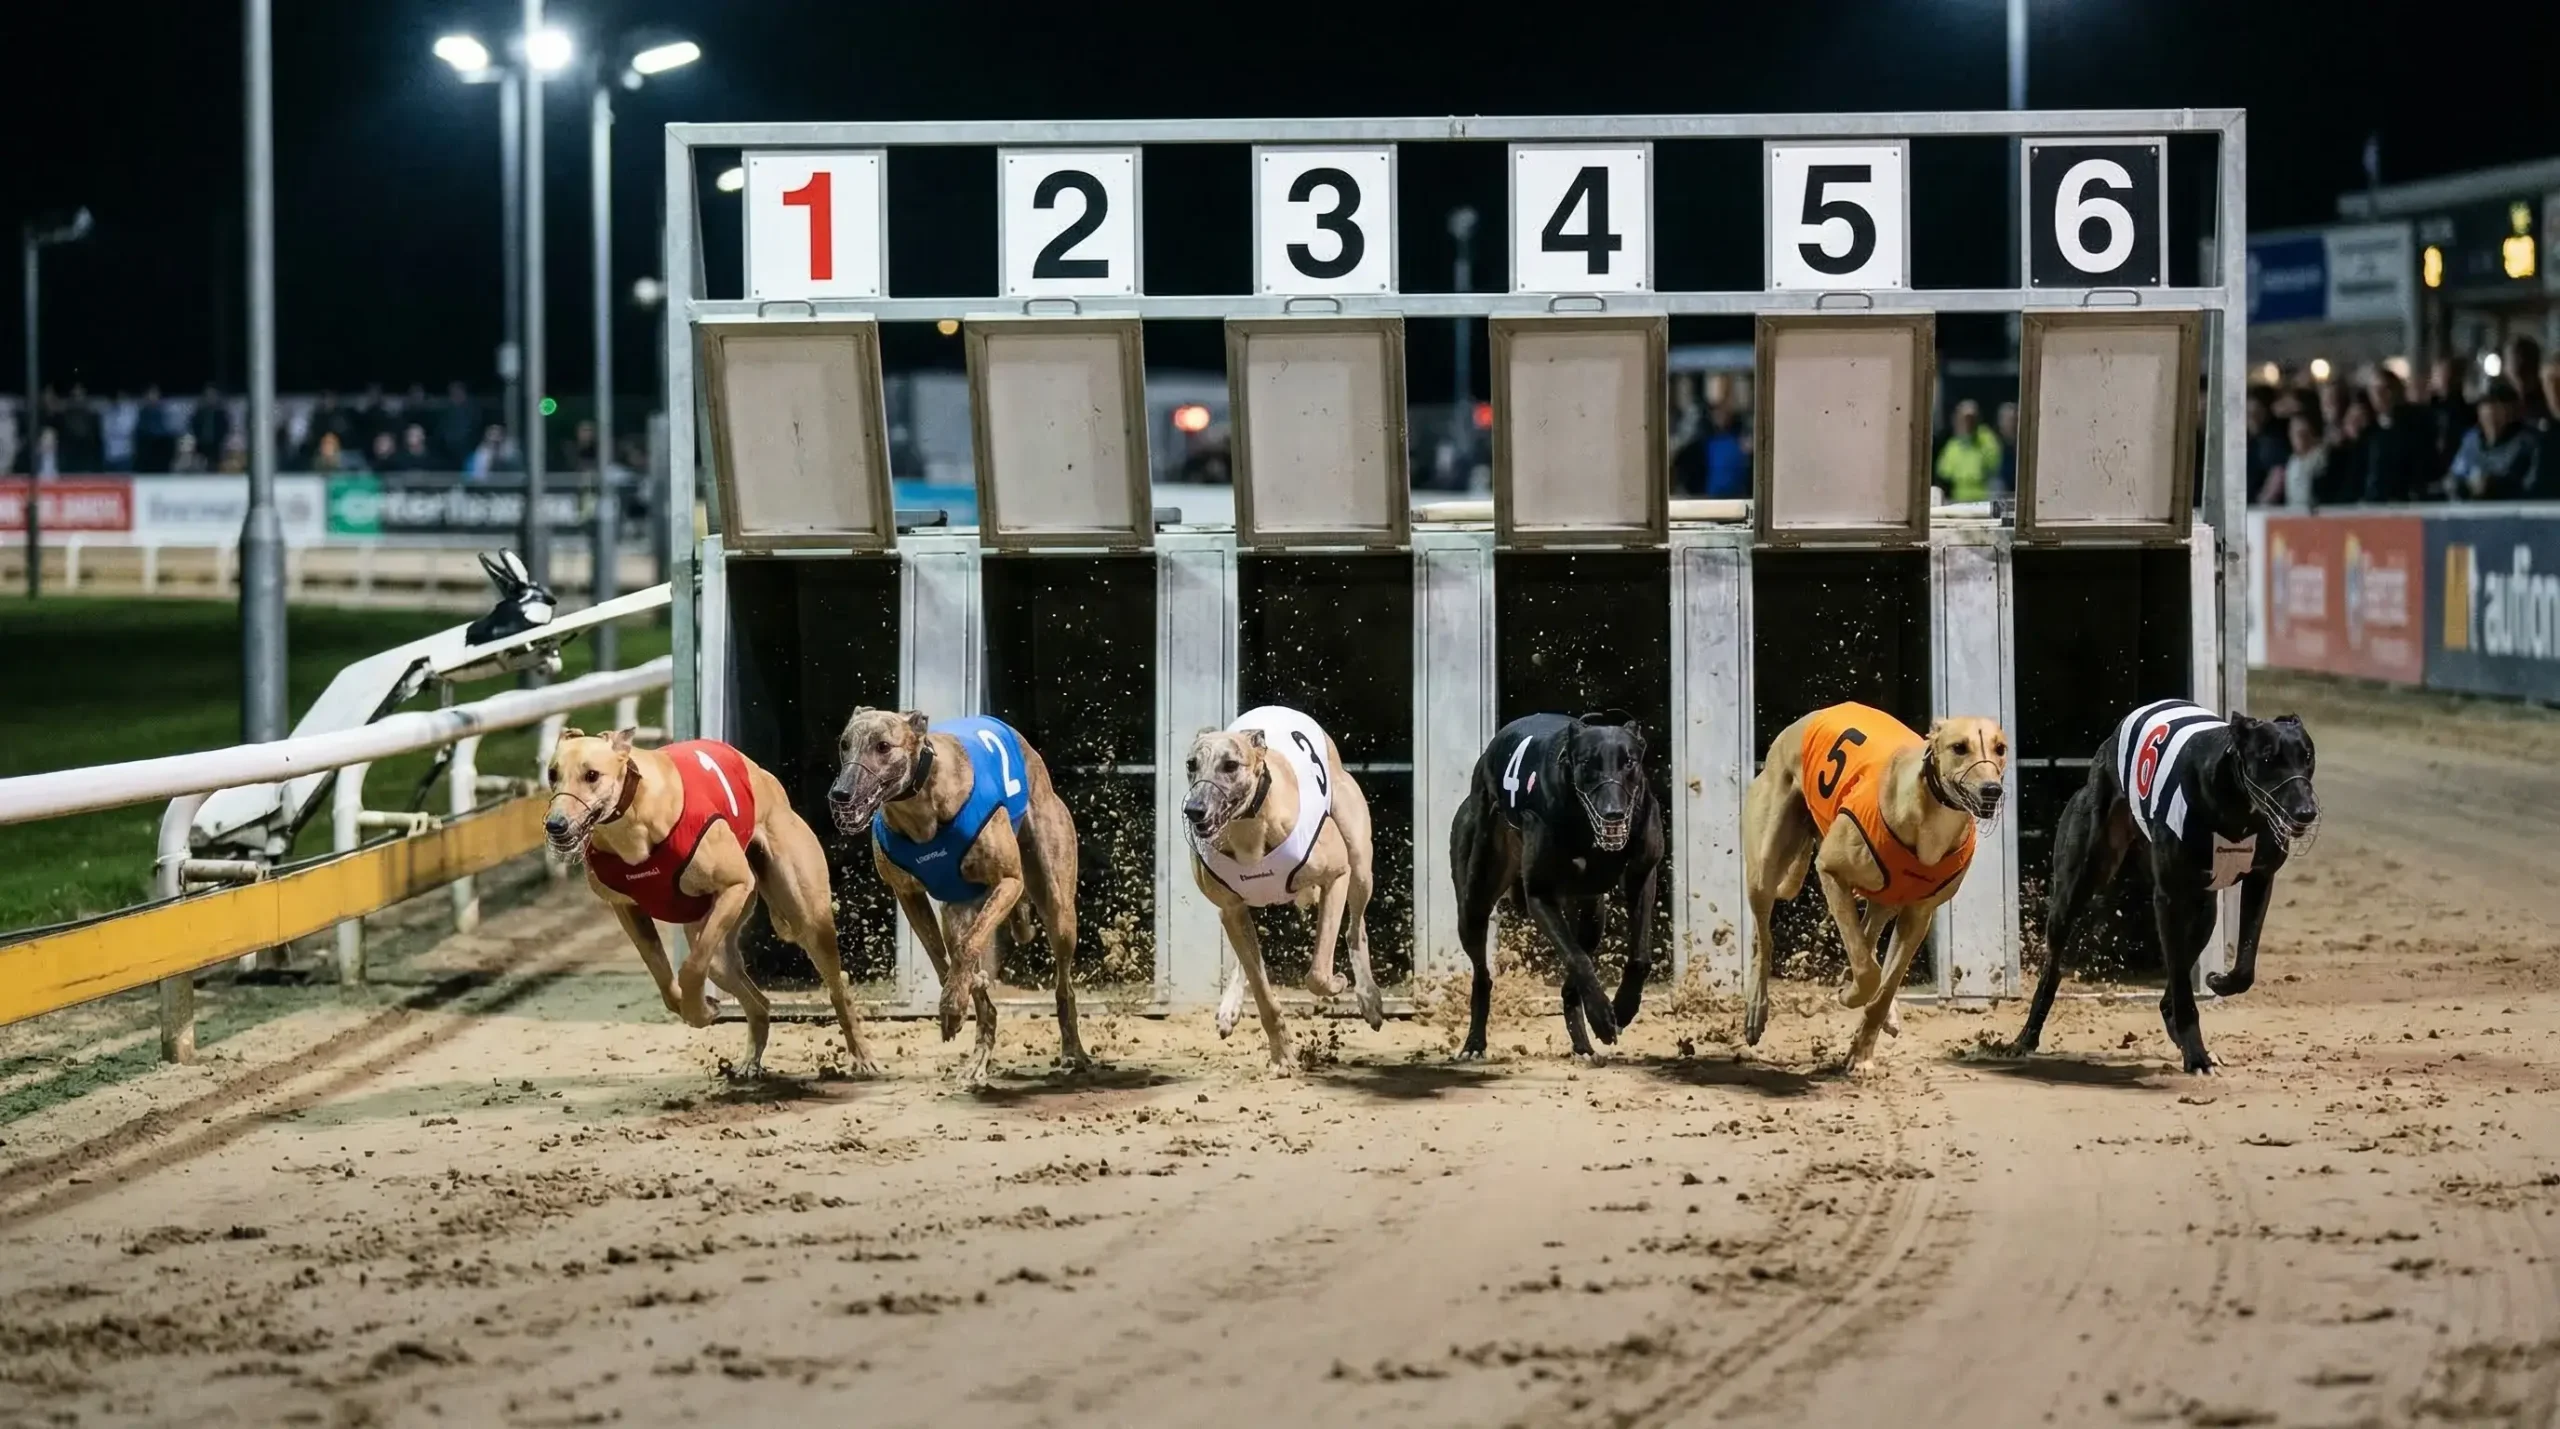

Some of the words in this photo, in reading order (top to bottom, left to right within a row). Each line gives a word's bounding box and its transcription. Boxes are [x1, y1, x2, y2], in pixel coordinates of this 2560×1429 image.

[783, 172, 832, 281] 1
[1033, 170, 1108, 278] 2
[1287, 168, 1364, 278] 3
[1542, 167, 1621, 274] 4
[1798, 165, 1876, 274] 5
[2054, 159, 2135, 273] 6
[694, 750, 739, 817] 1
[977, 729, 1021, 798] 2
[1290, 730, 1327, 797] 3
[1503, 735, 1533, 808] 4
[1818, 727, 1867, 799] 5
[2136, 723, 2170, 800] 6
